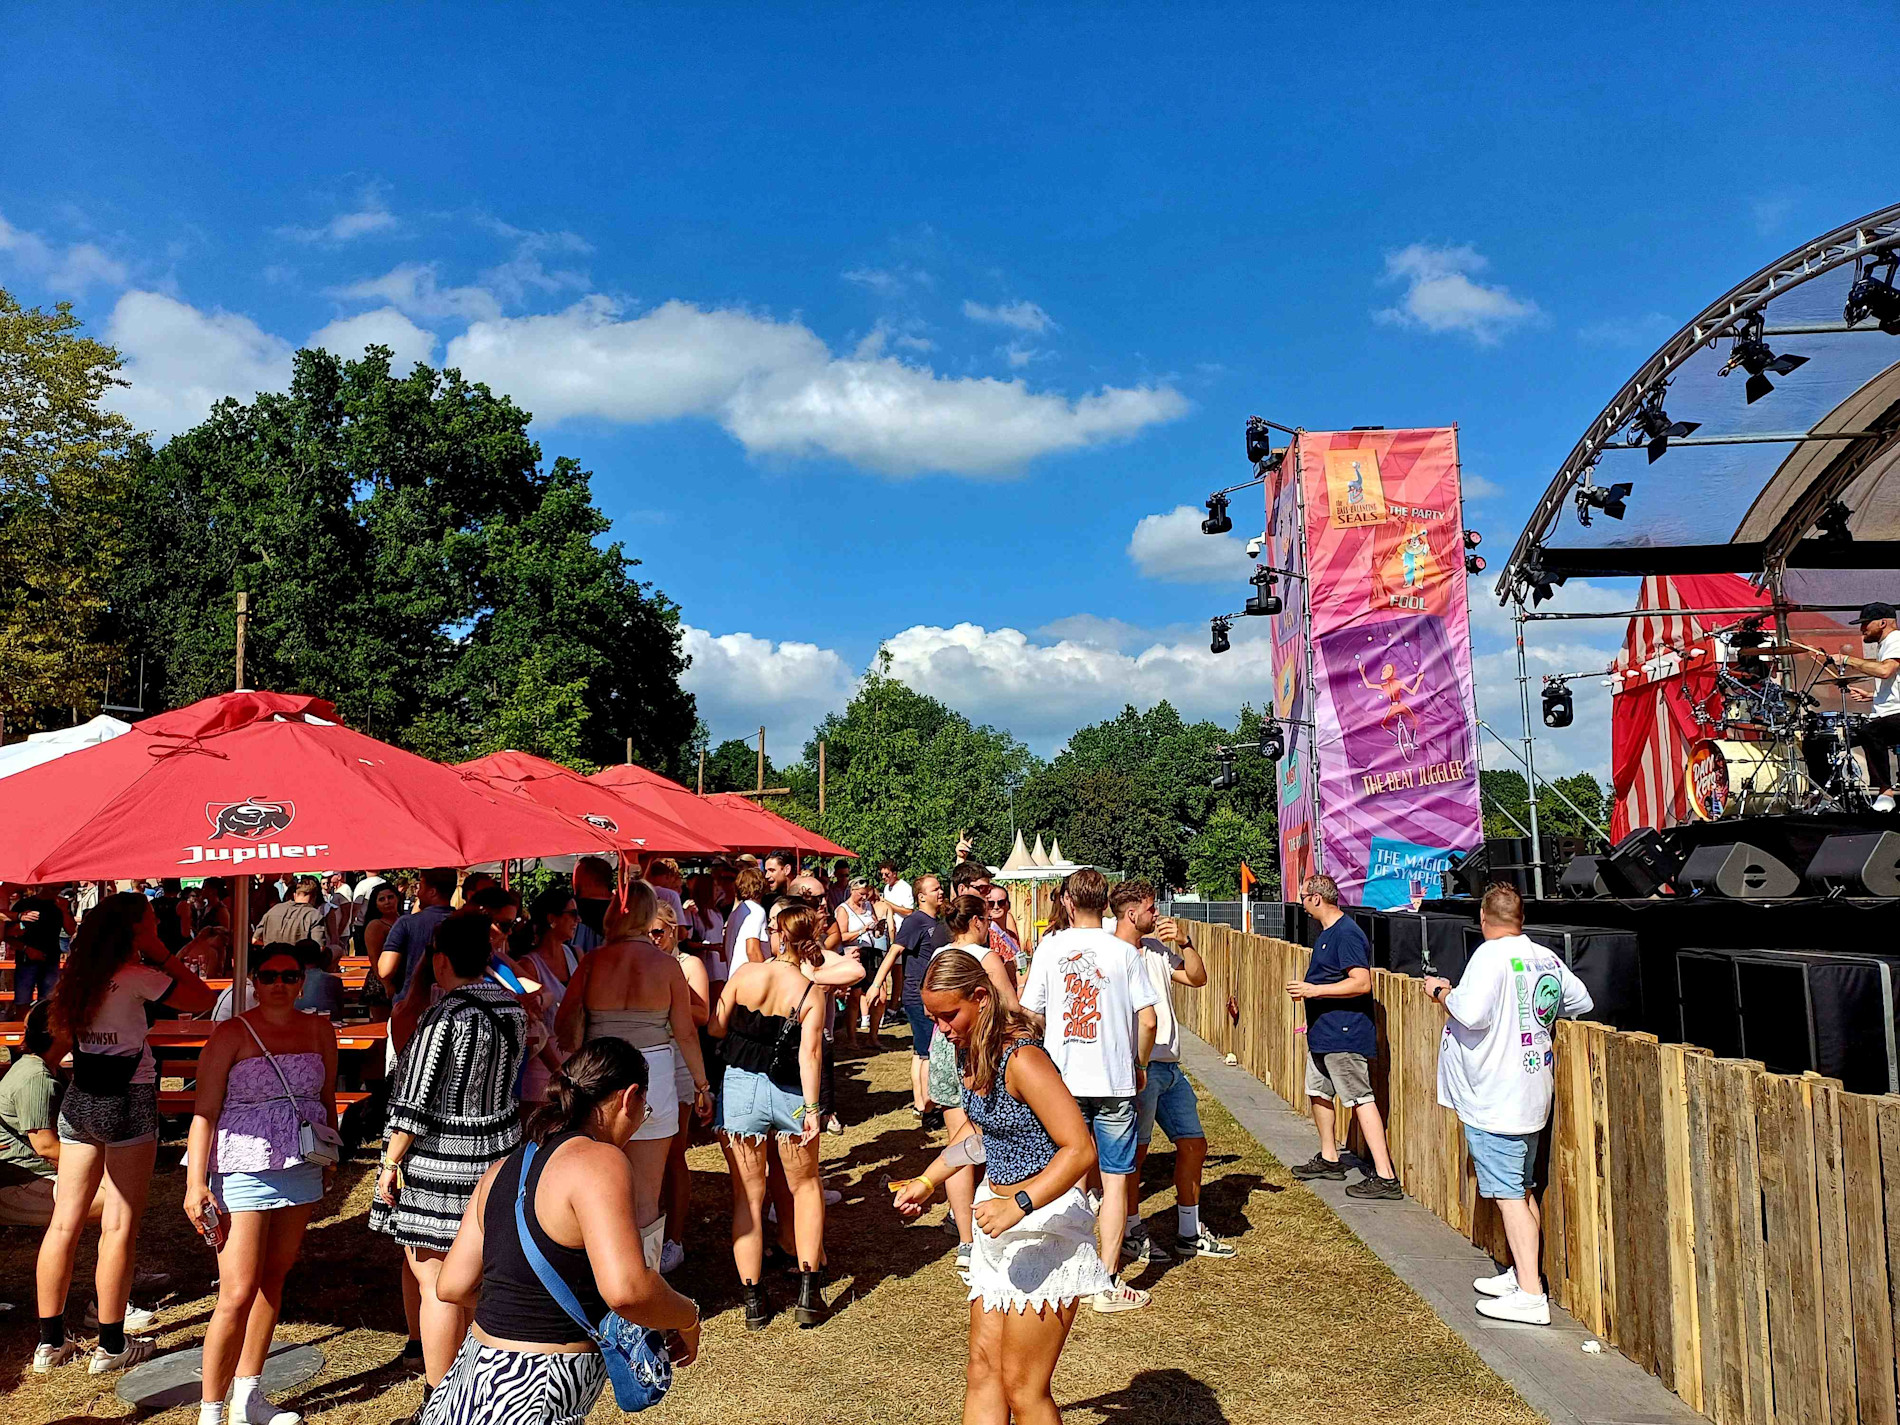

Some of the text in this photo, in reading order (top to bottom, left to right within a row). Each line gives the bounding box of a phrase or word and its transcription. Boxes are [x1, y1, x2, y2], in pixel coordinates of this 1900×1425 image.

[1337, 512, 1378, 525] SEALS
[1389, 505, 1446, 521] THE PARTY
[1389, 594, 1429, 611] FOOL
[1362, 759, 1466, 796] THE BEAT JUGGLER
[176, 842, 329, 865] Jupiler
[1376, 848, 1401, 866] THE
[1374, 863, 1390, 877] OF
